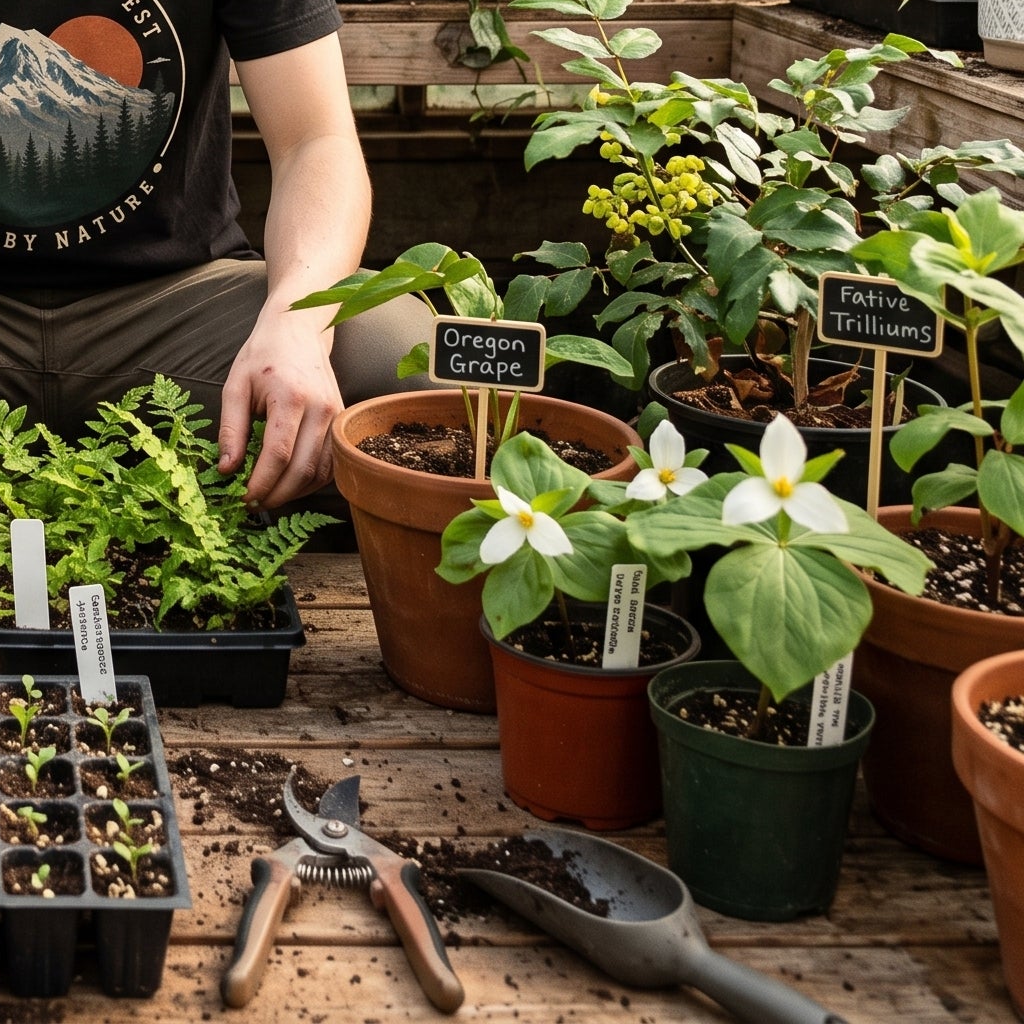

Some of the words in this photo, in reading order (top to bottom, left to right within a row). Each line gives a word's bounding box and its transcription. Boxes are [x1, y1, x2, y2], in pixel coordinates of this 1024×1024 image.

[3, 231, 36, 251] BY
[55, 179, 154, 249] NATURE
[840, 285, 911, 312] Fative
[829, 311, 932, 344] Trilliums
[443, 328, 526, 359] Oregon
[449, 353, 524, 382] Grape
